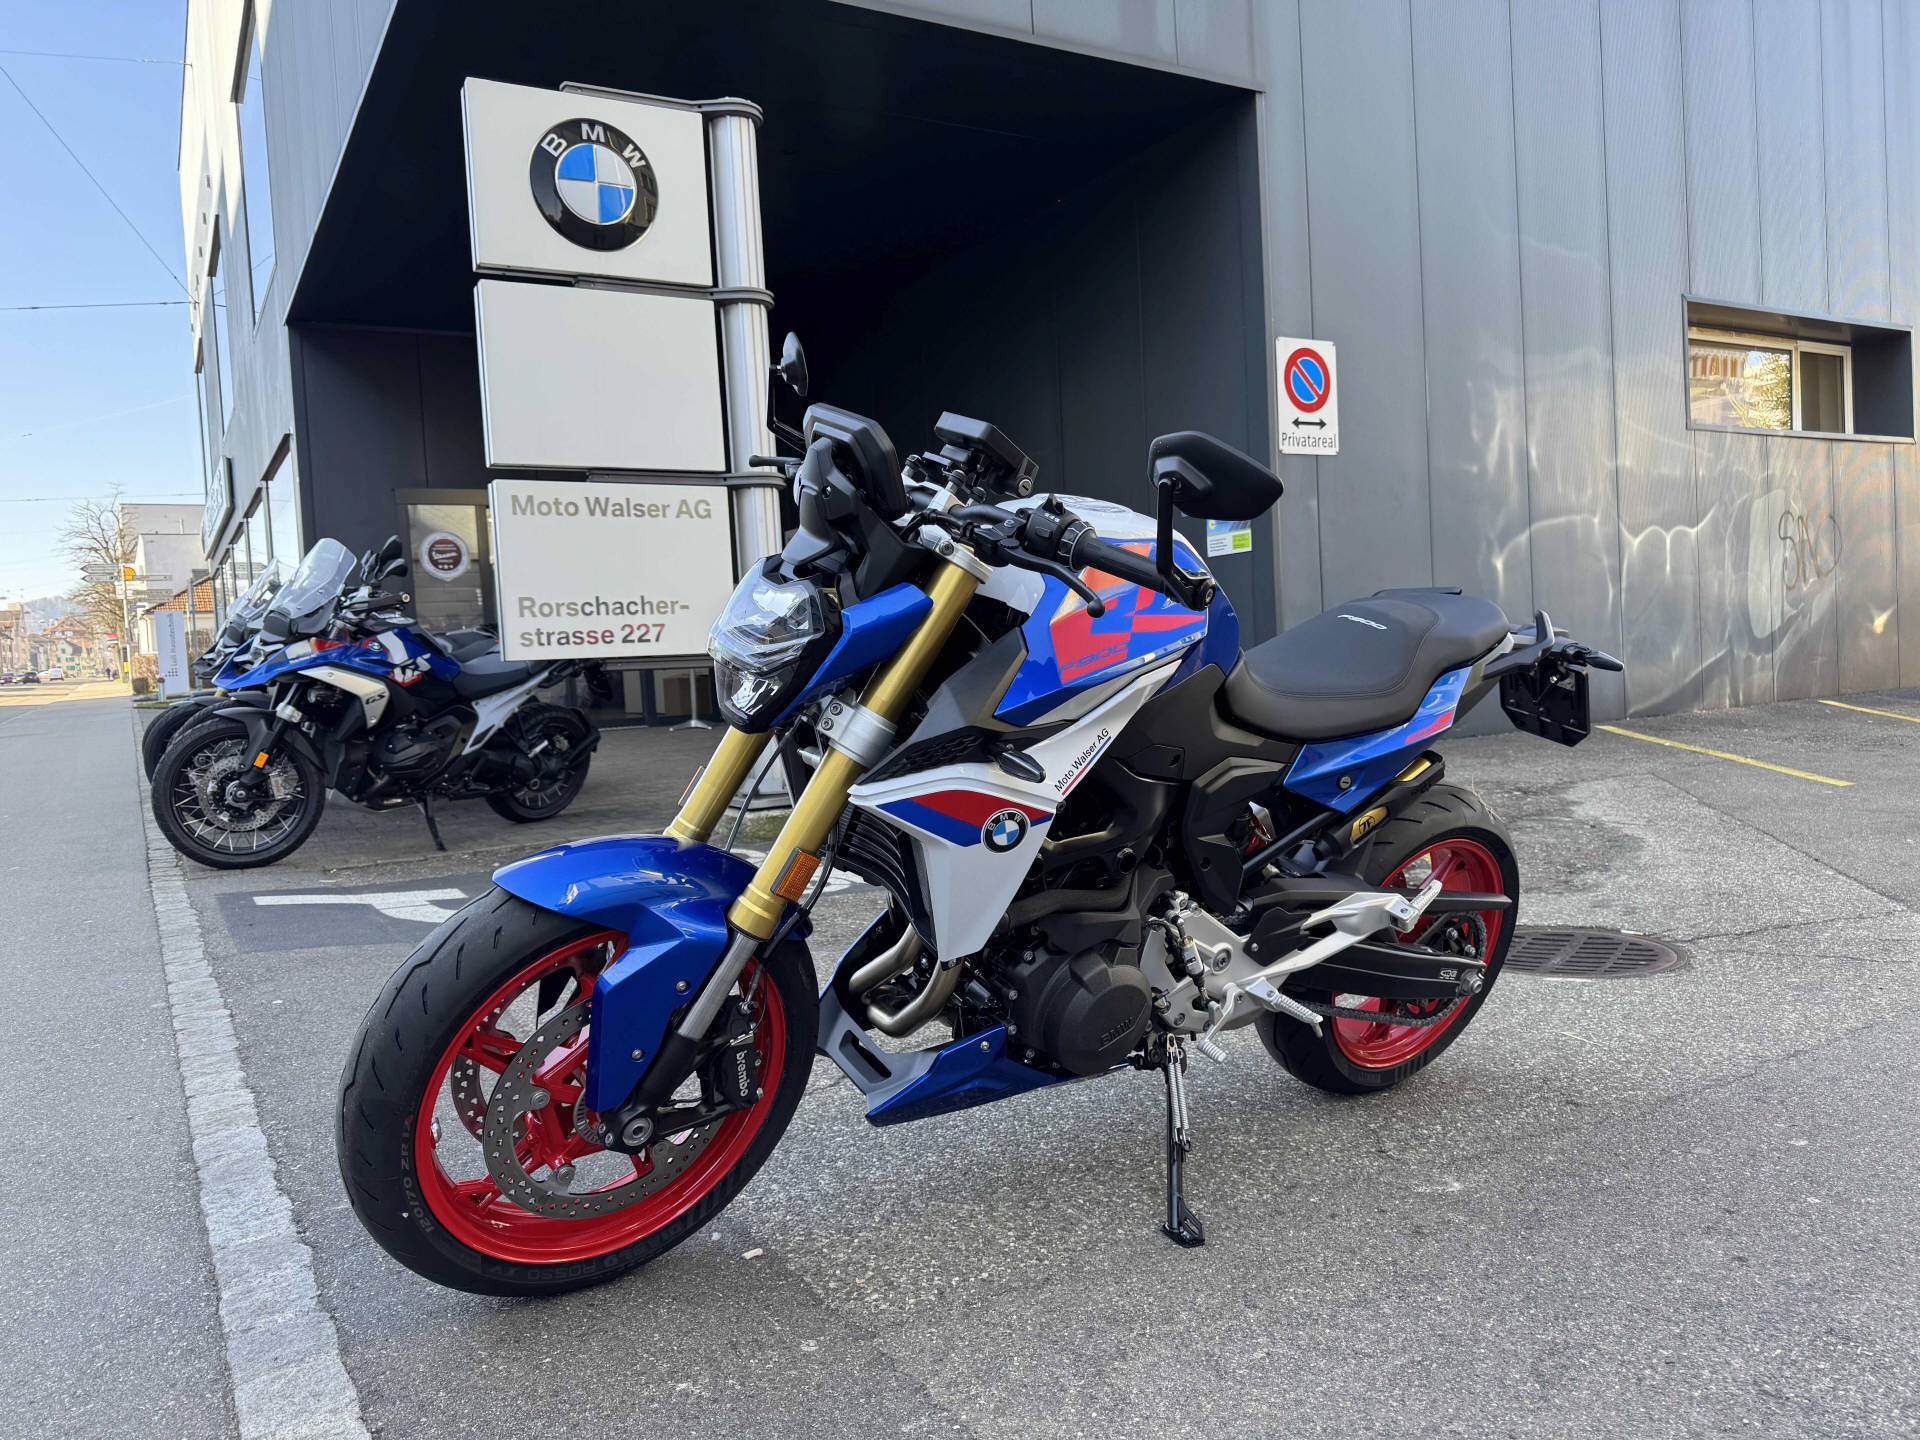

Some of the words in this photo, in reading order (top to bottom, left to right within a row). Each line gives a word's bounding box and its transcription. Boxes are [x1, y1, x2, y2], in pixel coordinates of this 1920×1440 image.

[541, 122, 646, 169] BMW
[1281, 432, 1337, 449] Privatareal
[511, 494, 579, 517] Moto
[584, 496, 670, 519] Walser
[675, 498, 712, 519] AG
[517, 595, 690, 618] Rorschacher-
[519, 626, 615, 648] strasse
[620, 623, 666, 644] 227
[364, 691, 387, 705] GS
[1054, 769, 1075, 792] Moto
[1072, 741, 1097, 771] Walser
[1095, 727, 1110, 745] AG
[987, 813, 1024, 831] BMW
[736, 1050, 750, 1097] brembo
[528, 1258, 598, 1281] ROSSO
